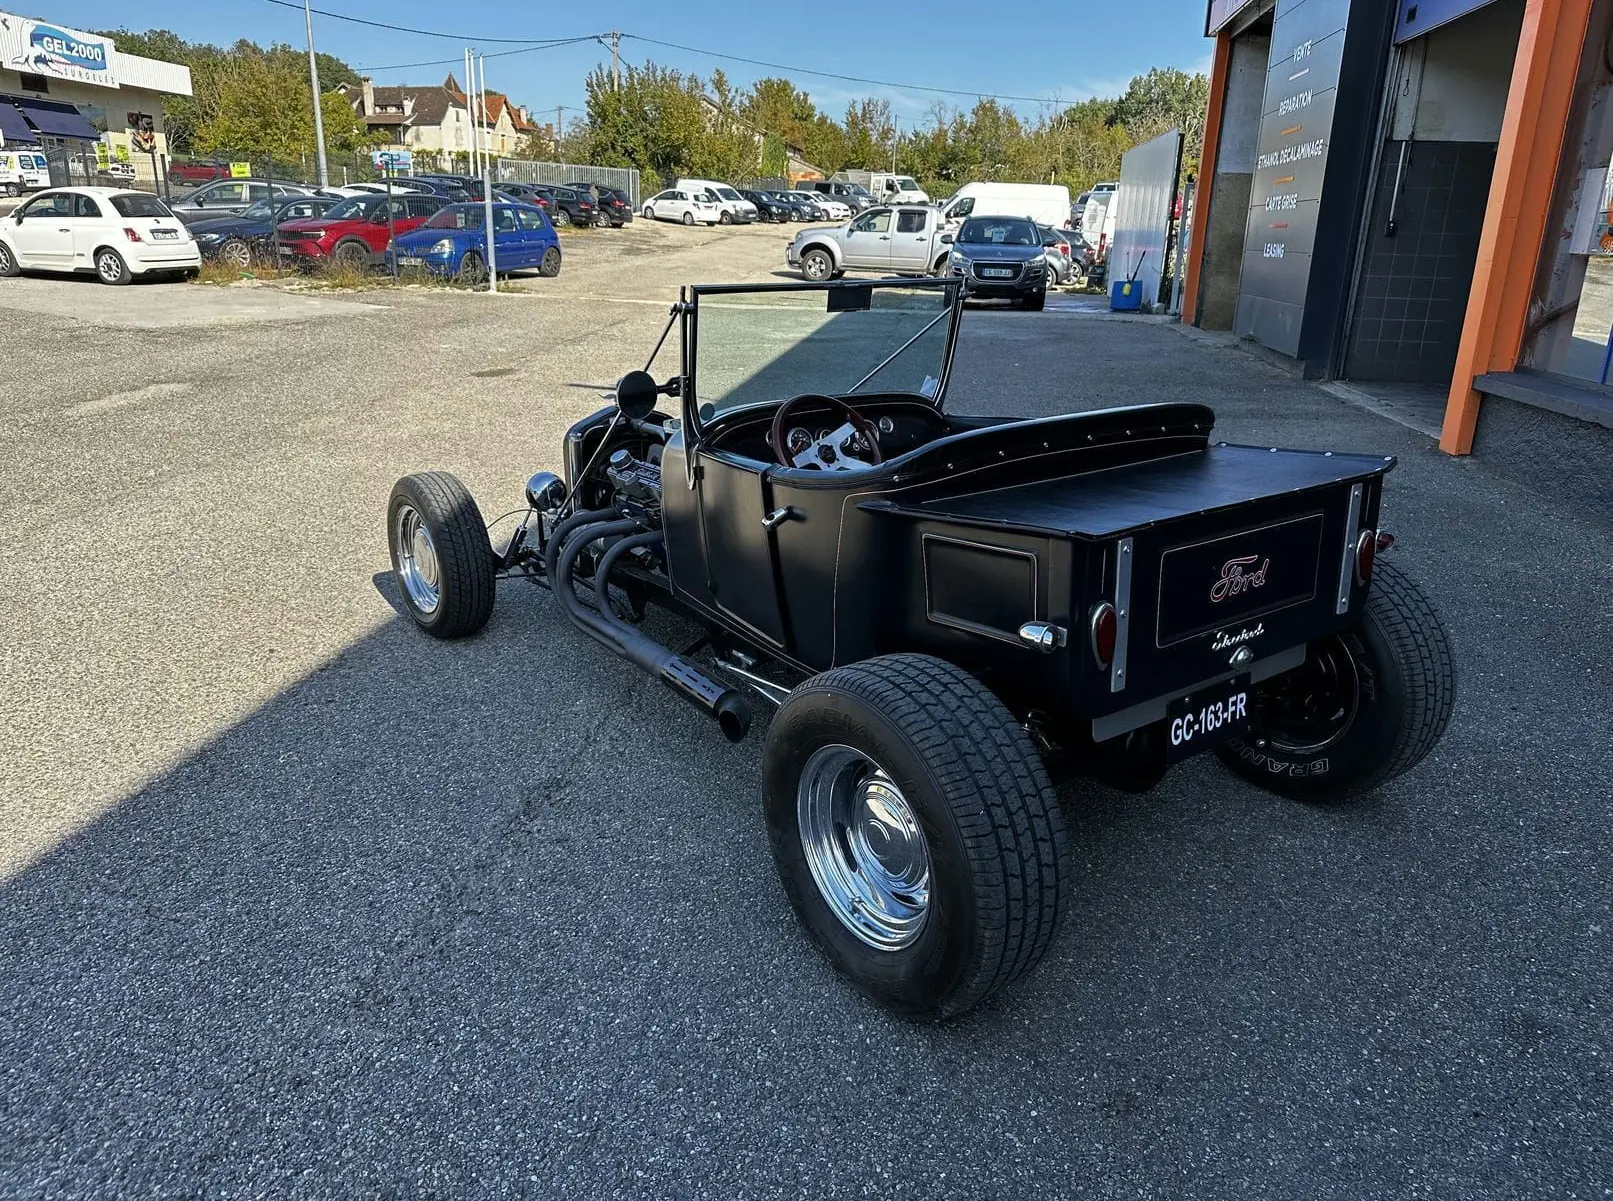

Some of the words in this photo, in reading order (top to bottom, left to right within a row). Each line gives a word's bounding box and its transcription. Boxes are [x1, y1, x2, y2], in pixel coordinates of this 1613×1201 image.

[43, 37, 103, 62] GEL2000
[1293, 39, 1313, 63] VENTE
[1265, 196, 1282, 211] CARTE
[1281, 193, 1298, 210] GRISE
[1263, 243, 1285, 258] LEASING
[1210, 555, 1269, 602] Ford
[1171, 692, 1247, 745] GC-163-FR
